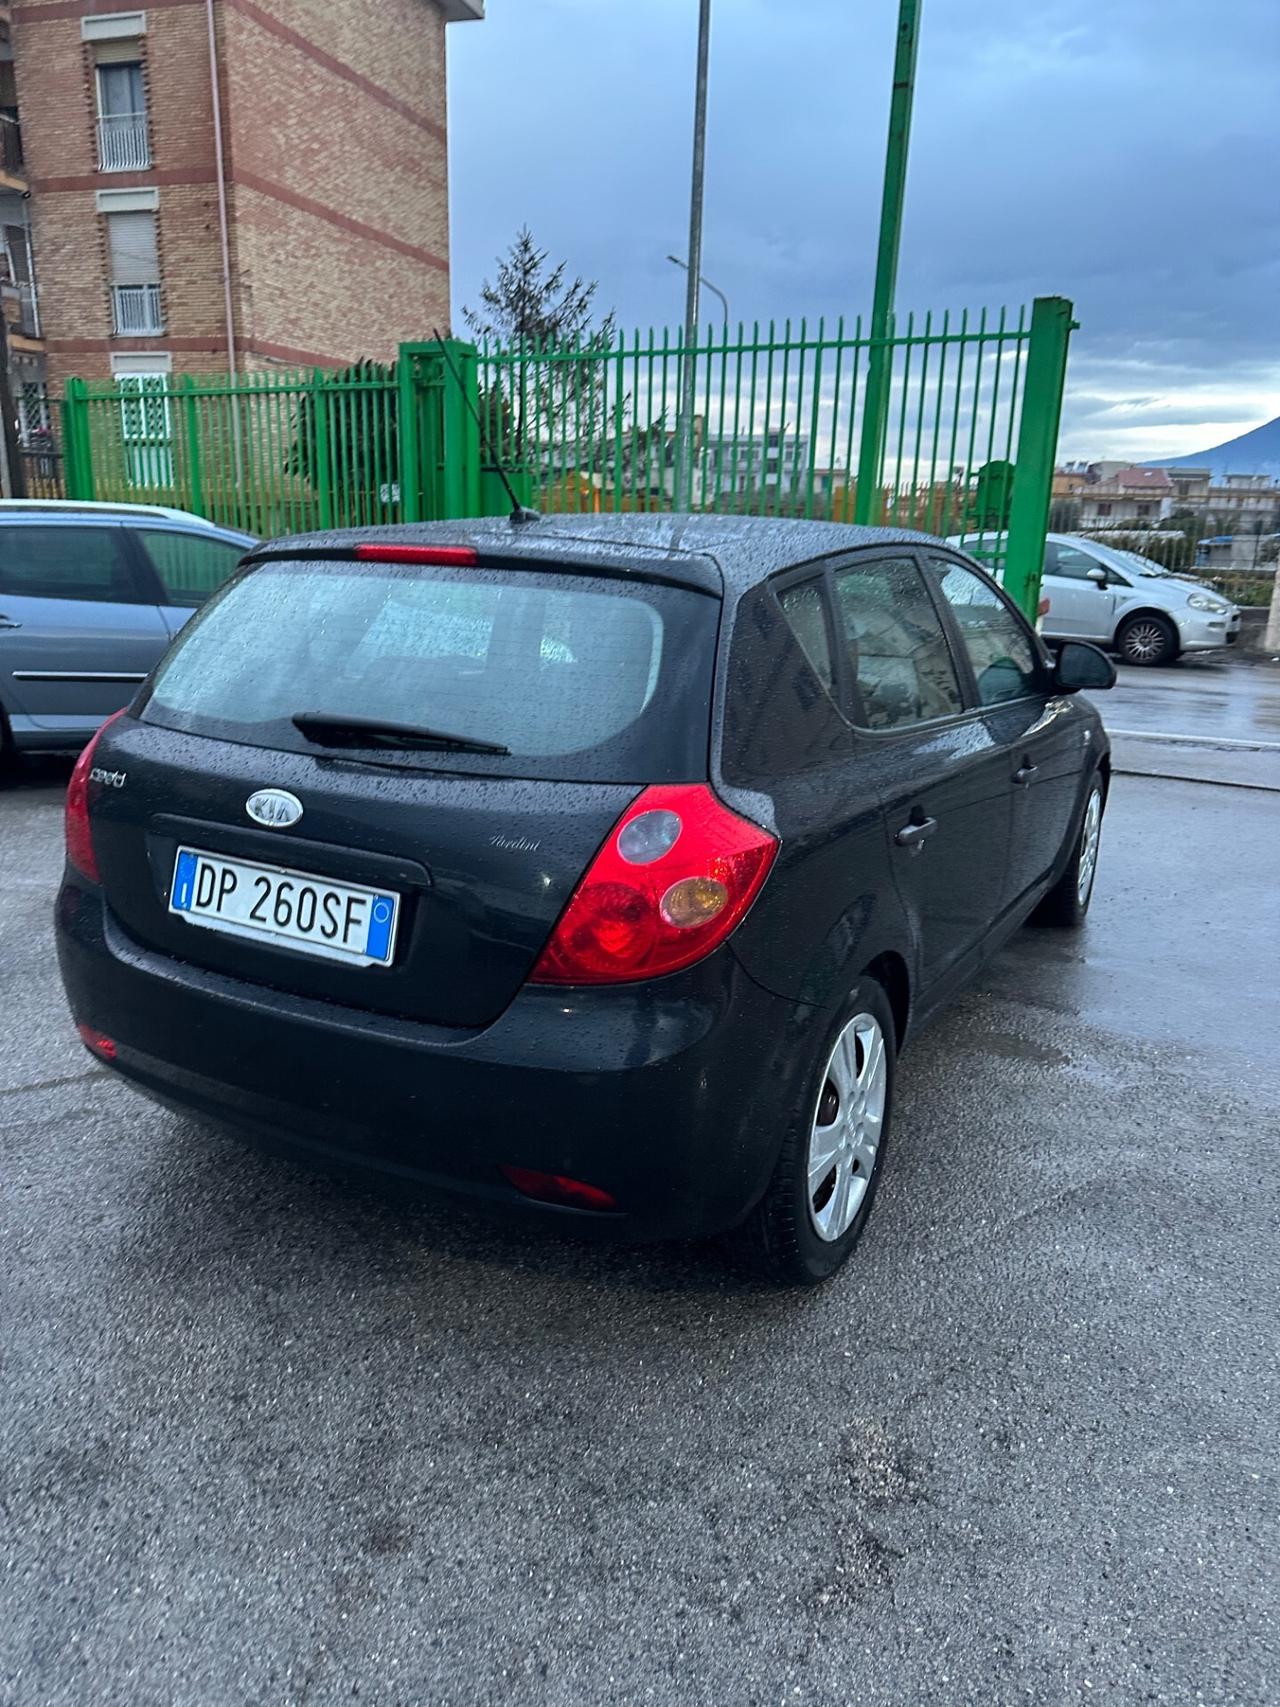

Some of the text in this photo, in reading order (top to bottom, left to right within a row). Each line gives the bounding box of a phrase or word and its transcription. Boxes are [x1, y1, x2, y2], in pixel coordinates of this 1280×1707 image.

[252, 796, 293, 823] KIA
[196, 862, 367, 943] DP 260SF
